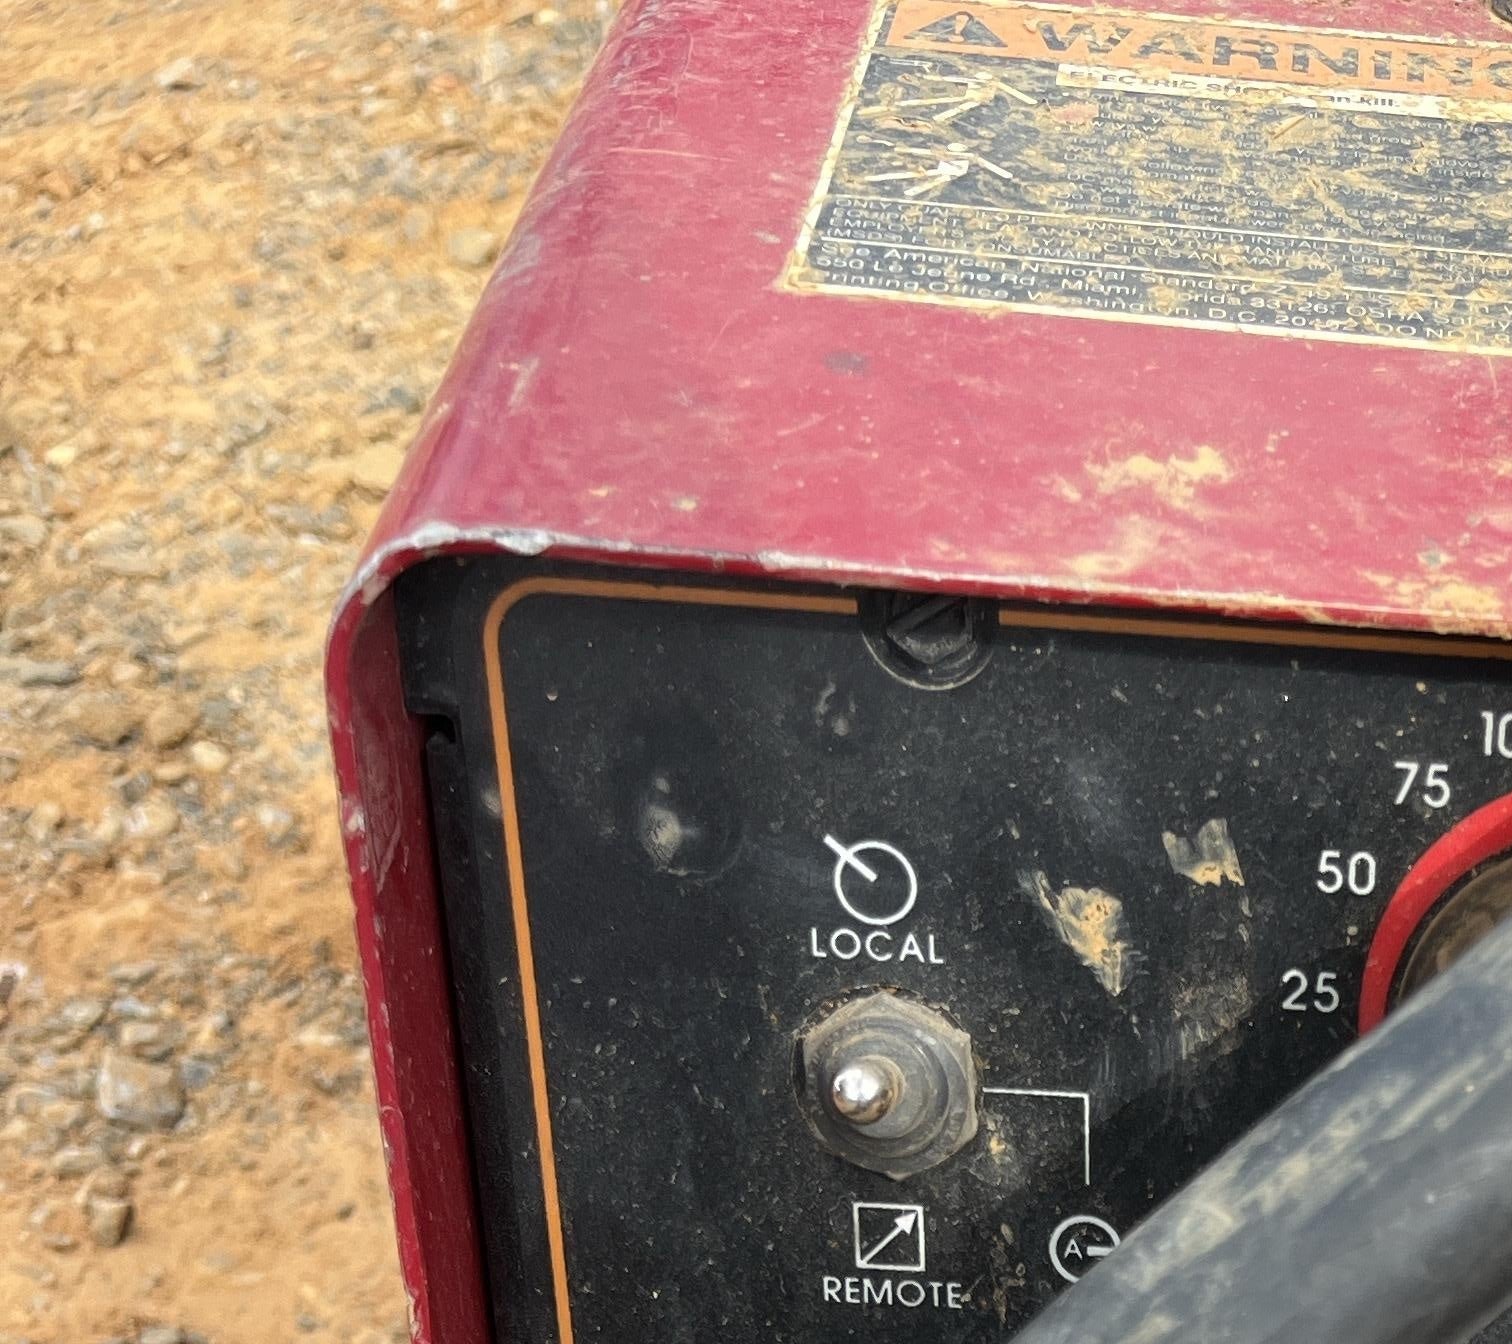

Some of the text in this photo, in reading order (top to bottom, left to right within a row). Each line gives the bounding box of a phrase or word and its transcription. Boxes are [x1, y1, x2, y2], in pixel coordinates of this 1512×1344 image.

[883, 247, 1007, 271] American
[1394, 761, 1451, 809] 75
[1316, 852, 1377, 895] 50
[809, 927, 944, 965] LOCAL
[1280, 970, 1341, 1013] 25
[822, 1276, 963, 1310] REMOTE
